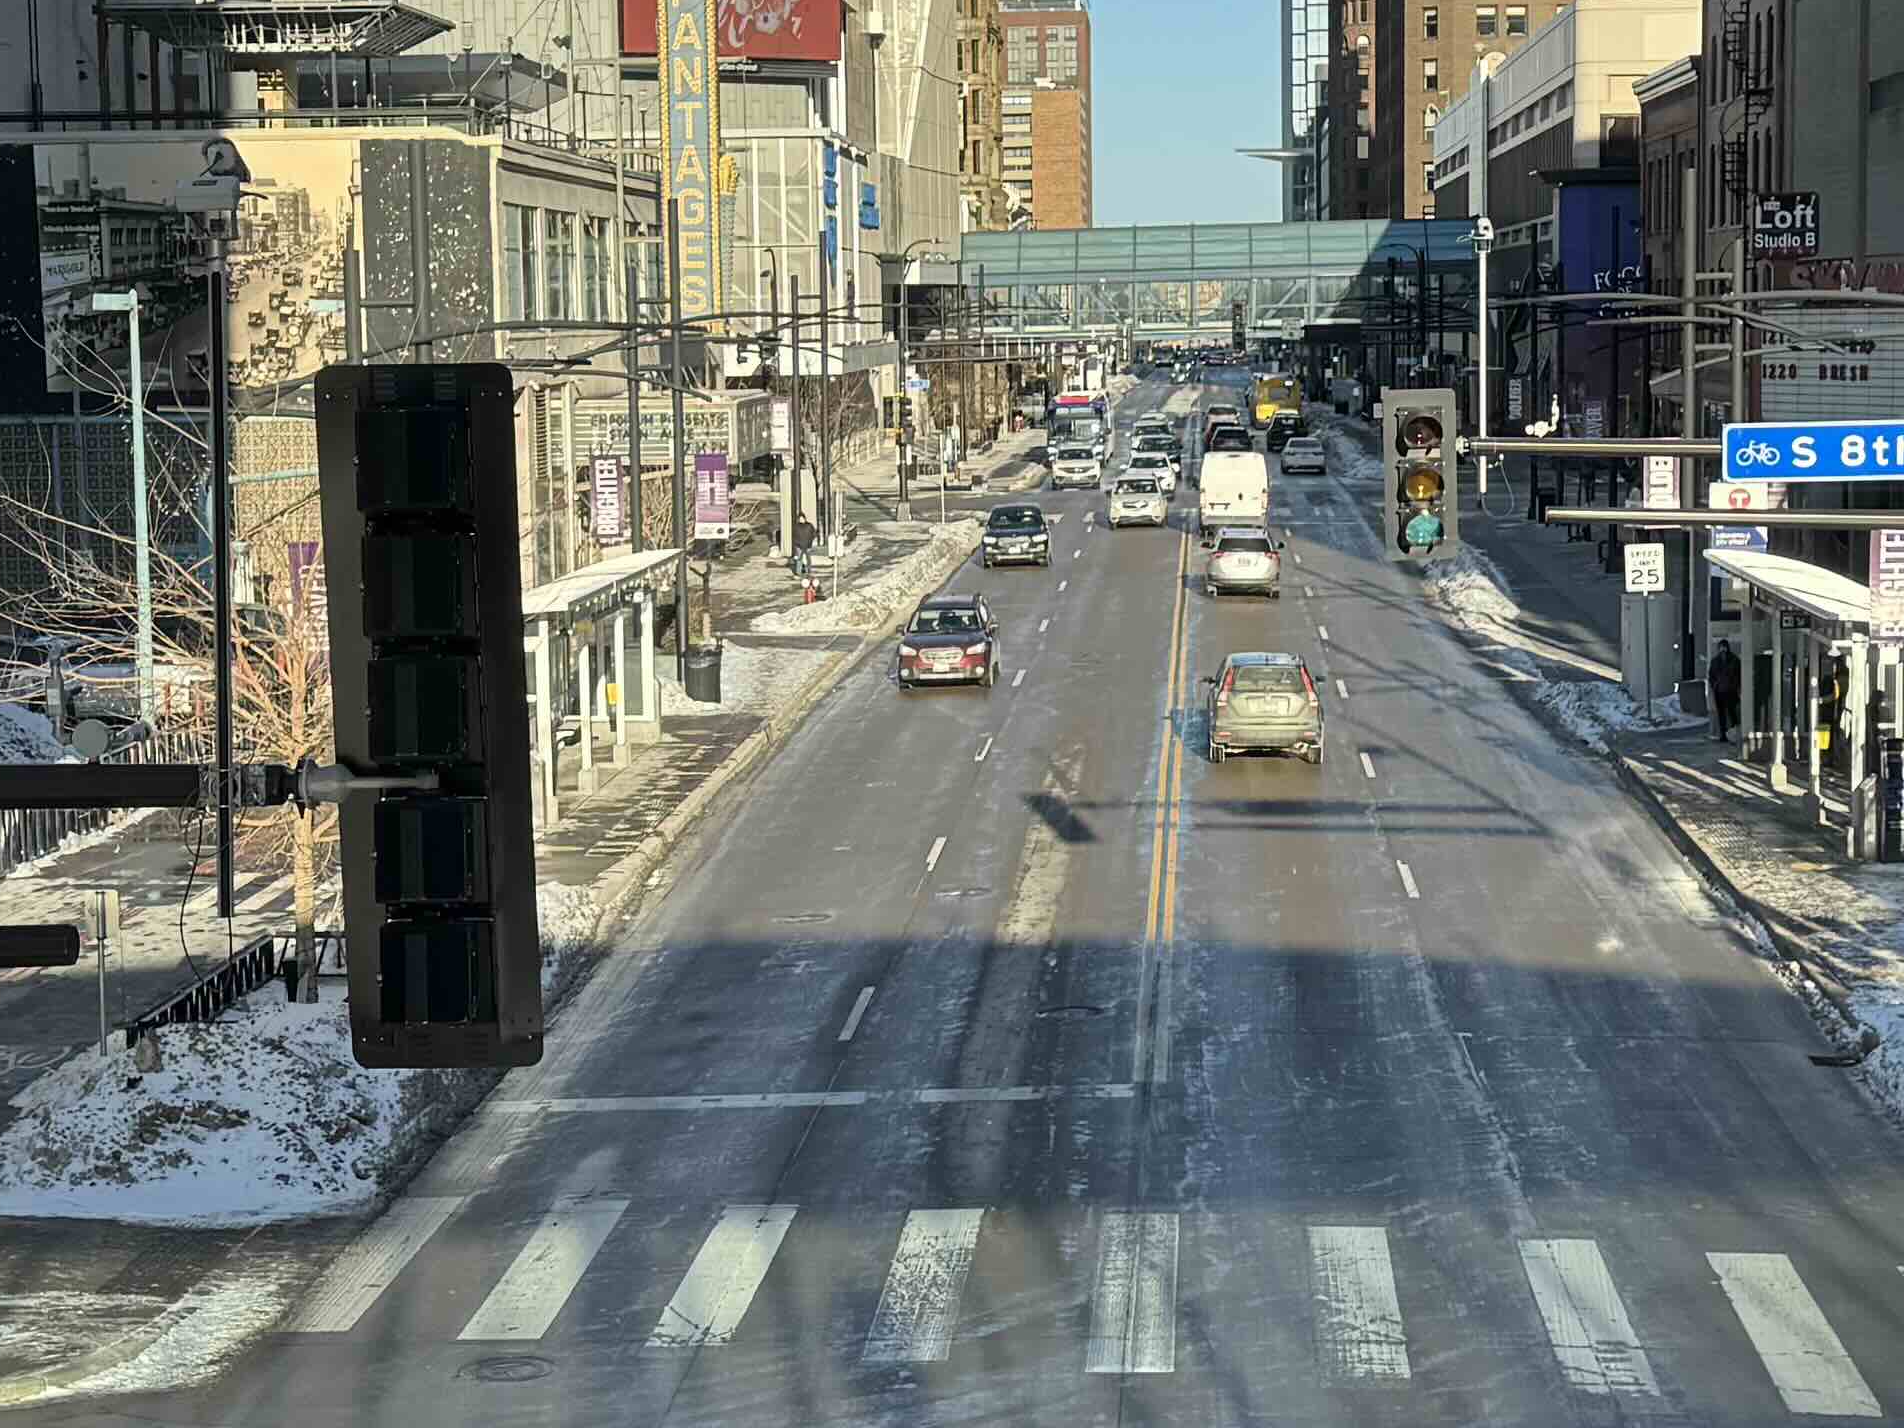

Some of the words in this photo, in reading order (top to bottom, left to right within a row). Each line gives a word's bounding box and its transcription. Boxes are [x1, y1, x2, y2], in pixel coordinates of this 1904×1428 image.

[1755, 196, 1815, 229] Loft
[1754, 233, 1800, 248] Studio
[1805, 232, 1816, 246] B
[1762, 364, 1797, 380] 1220
[1791, 436, 1817, 468] S
[1631, 569, 1660, 585] 25
